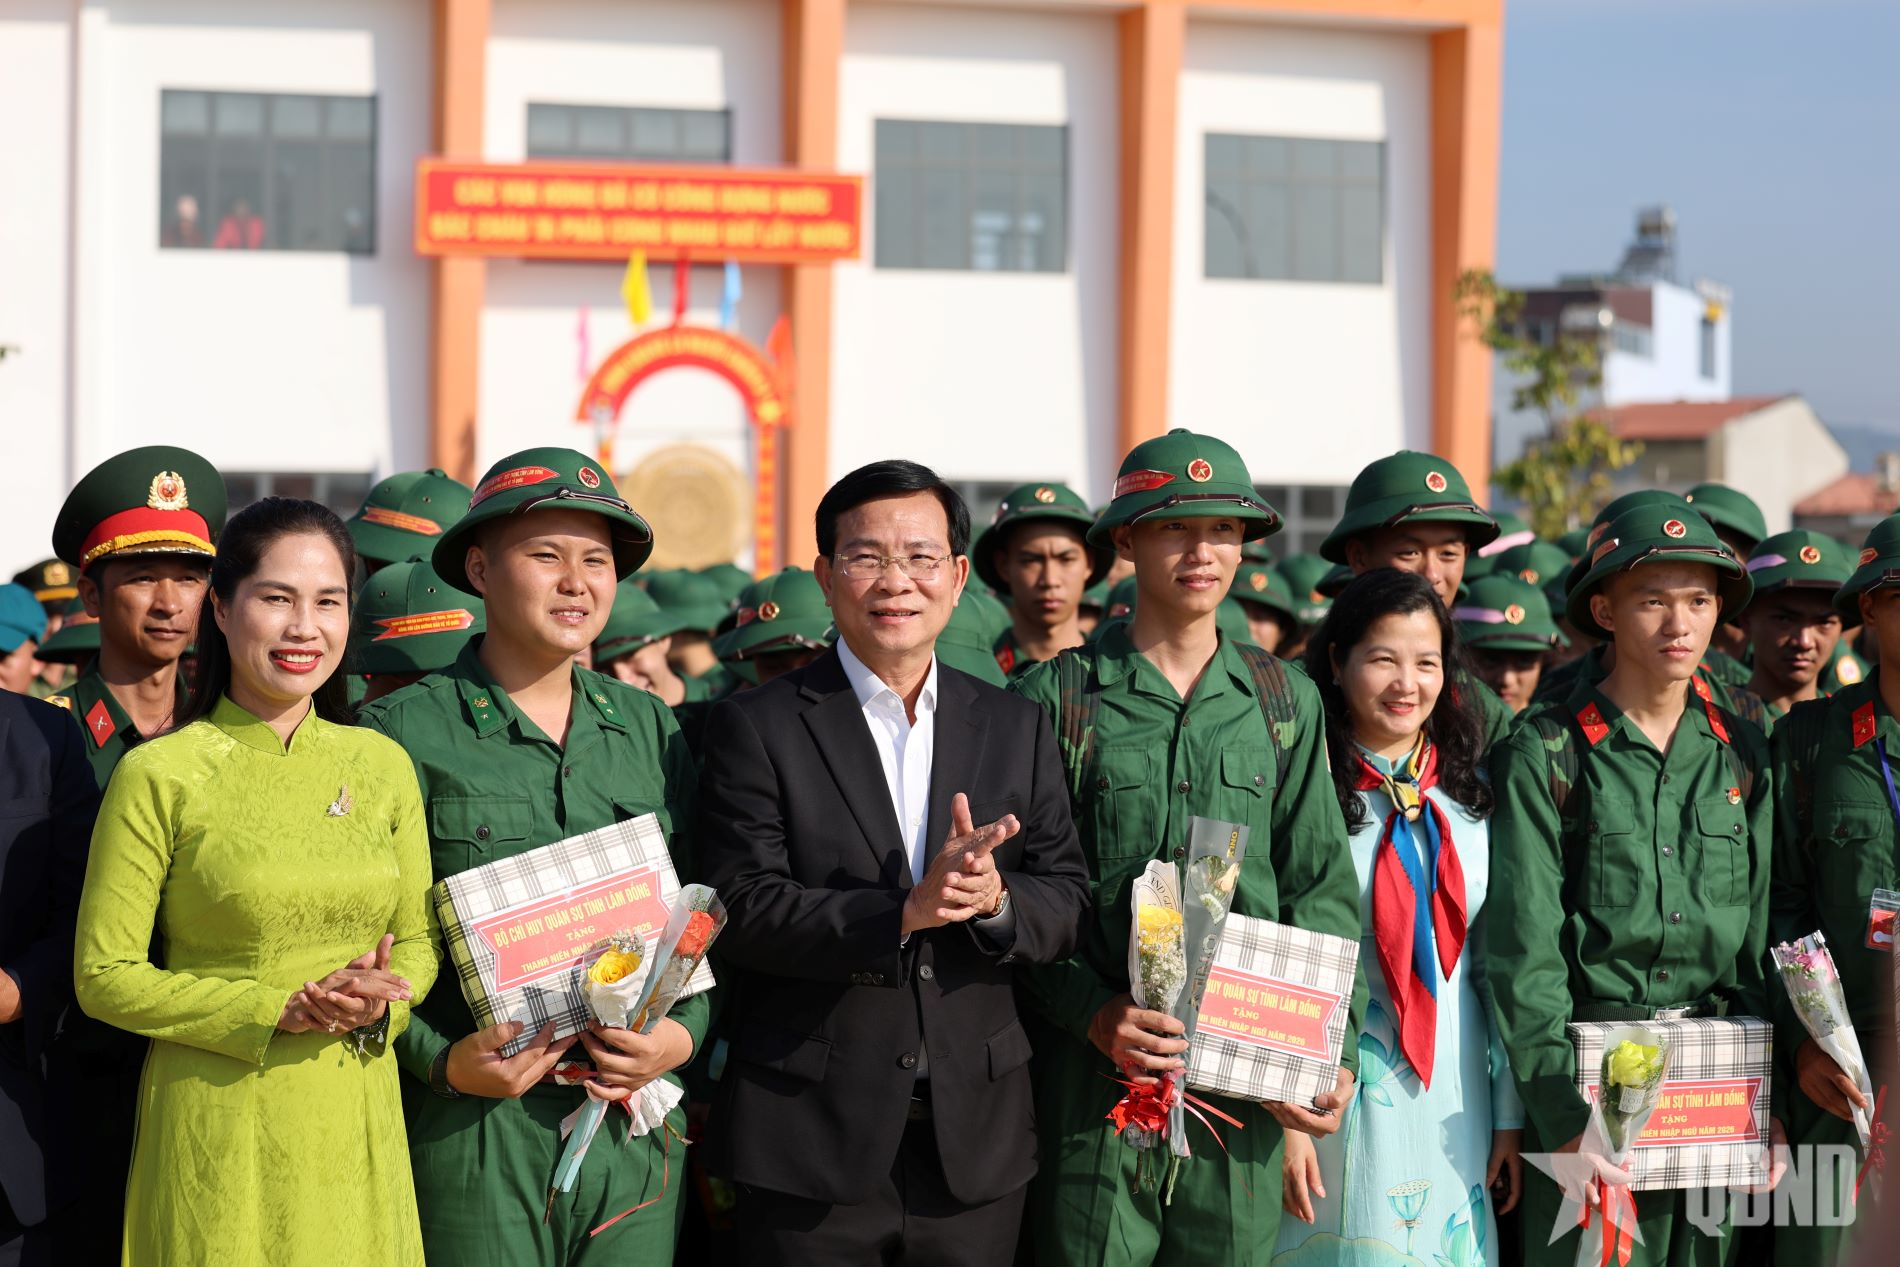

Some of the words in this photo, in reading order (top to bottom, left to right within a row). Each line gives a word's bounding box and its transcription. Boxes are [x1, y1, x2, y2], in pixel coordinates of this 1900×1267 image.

[493, 926, 510, 949] BỘ
[508, 918, 527, 943] CHỈ
[525, 918, 545, 937] HUY
[544, 908, 571, 932] QUÂN
[570, 905, 585, 923] SỰ
[585, 896, 606, 918] TỈNH
[604, 891, 626, 910] LÂM
[624, 880, 652, 903] ĐỒNG
[565, 924, 596, 942] TẶNG
[520, 955, 550, 973] THANH
[549, 948, 571, 963] NIÊN
[1222, 981, 1247, 1000] QUÂN
[1246, 987, 1260, 1008] SỰ
[1260, 987, 1279, 1009] TỈNH
[1279, 994, 1298, 1014] LÂM
[1298, 998, 1322, 1020] ĐỒNG
[1232, 1007, 1260, 1021] TẶNG
[1210, 1015, 1228, 1028] NIÊN
[1229, 1020, 1250, 1034] NHẬP
[1250, 1025, 1267, 1039] NGŨ
[1268, 1029, 1286, 1042] NĂM
[1286, 1034, 1306, 1047] 2026
[1672, 1095, 1684, 1112] SỰ
[1685, 1090, 1704, 1109] TỈNH
[1705, 1091, 1723, 1107] LÂM
[1724, 1087, 1745, 1106] ĐỒNG
[1660, 1127, 1680, 1138] NHẬP
[1681, 1126, 1697, 1137] NGŨ
[1699, 1125, 1716, 1136] NĂM
[1717, 1124, 1735, 1134] 2026
[1661, 1115, 1688, 1125] TẶNG
